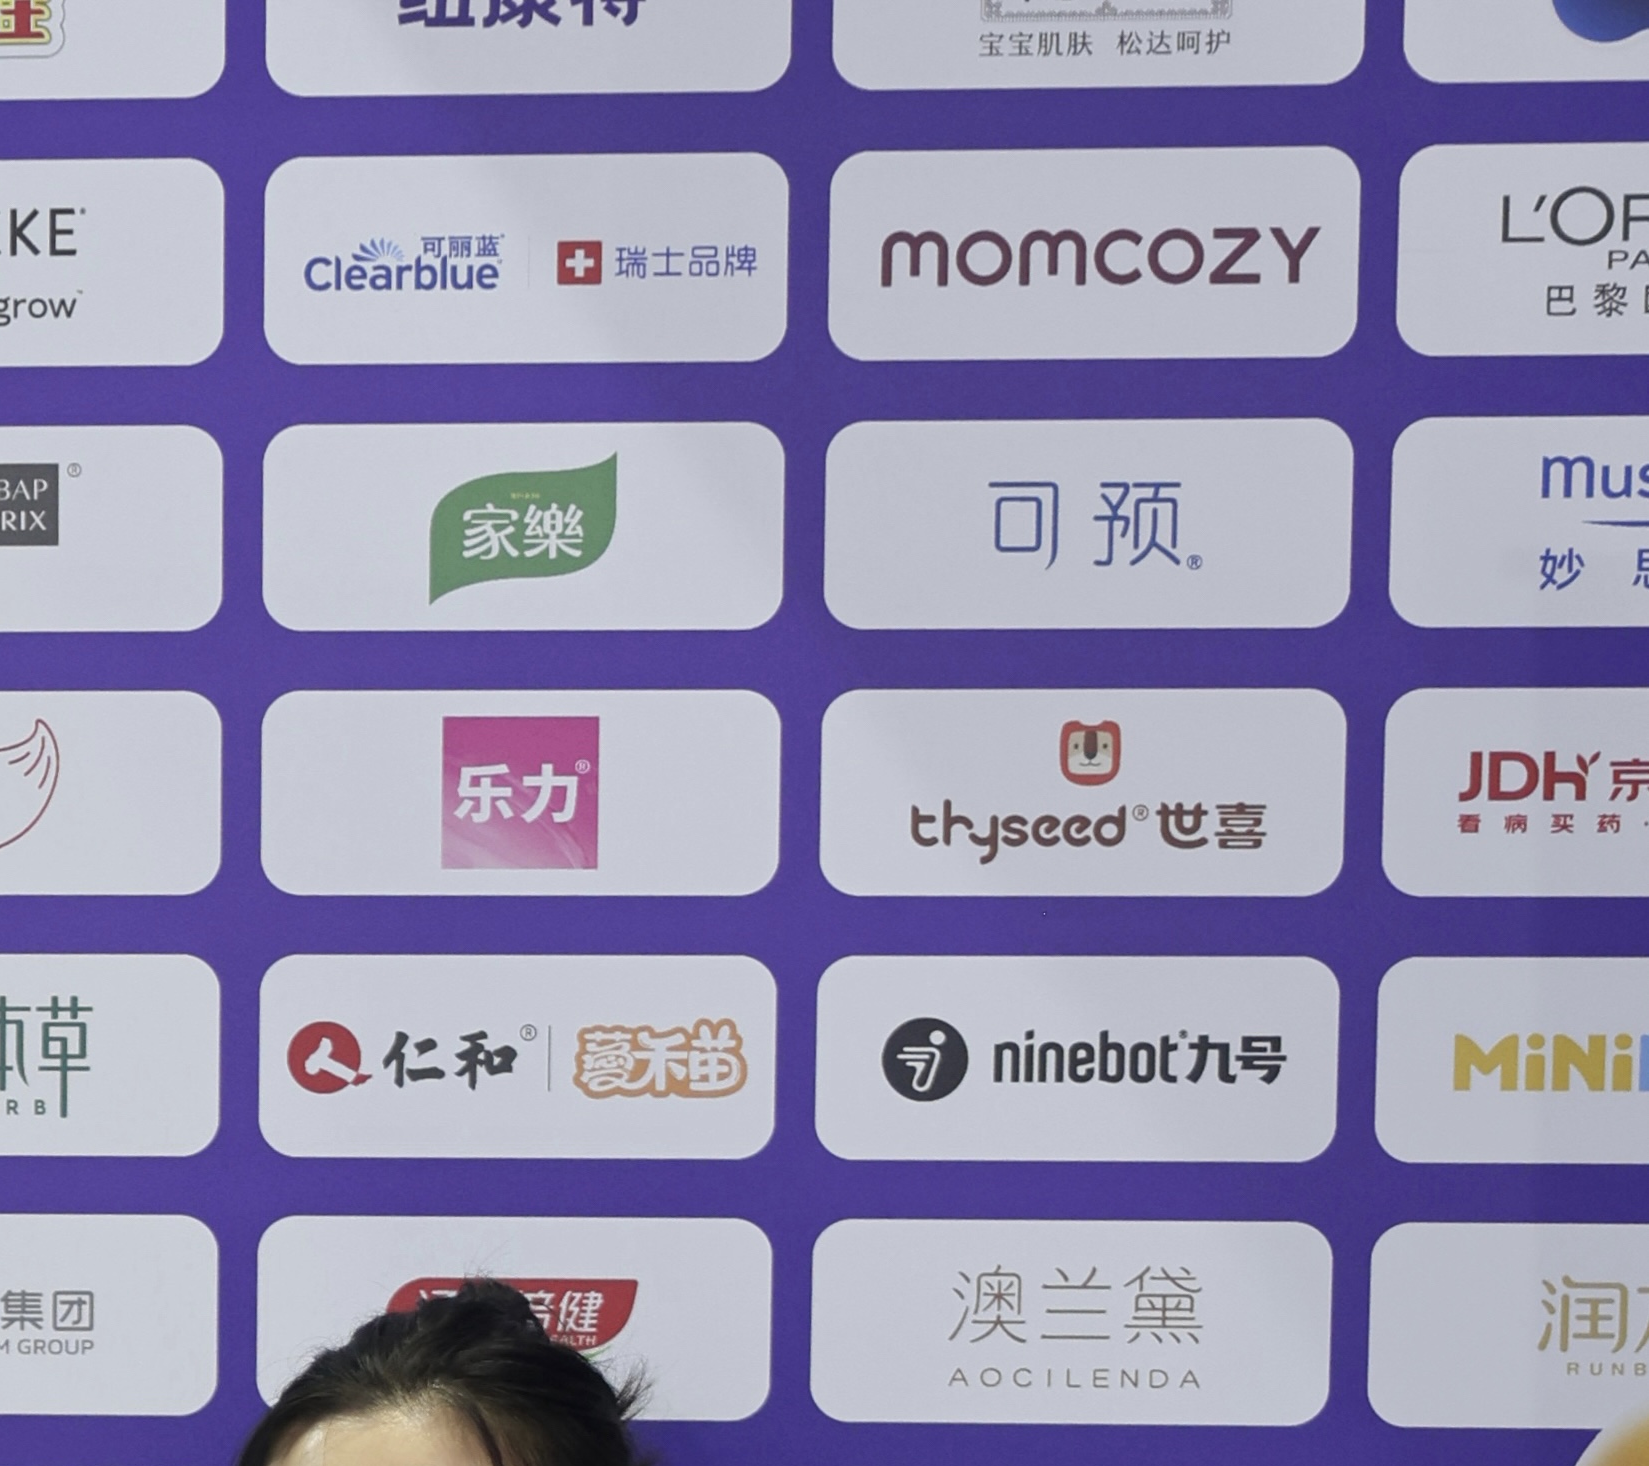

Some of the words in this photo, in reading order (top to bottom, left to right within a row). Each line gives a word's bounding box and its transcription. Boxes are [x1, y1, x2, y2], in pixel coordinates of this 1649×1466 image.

[980, 31, 1092, 56] 宝宝肌肤
[1117, 29, 1230, 55] 松达呵护
[419, 233, 499, 259] 可丽蓝
[615, 245, 757, 279] 瑞士品牌
[303, 255, 500, 291] Clearblue
[1547, 283, 1649, 317] 巴黎
[988, 482, 1181, 569] 可预
[453, 763, 579, 824] 乐力
[911, 799, 1126, 865] thyseed
[1156, 803, 1266, 848] 世喜
[1458, 814, 1621, 833] 看病买药
[383, 1031, 517, 1090] 仁和
[994, 1030, 1178, 1083] ninebot
[1187, 1034, 1288, 1085] 九号
[949, 1265, 1203, 1344] 澳兰黛
[1538, 1275, 1649, 1353] 润
[17, 1339, 94, 1355] GROUP
[948, 1368, 1200, 1389] AOCILENDA
